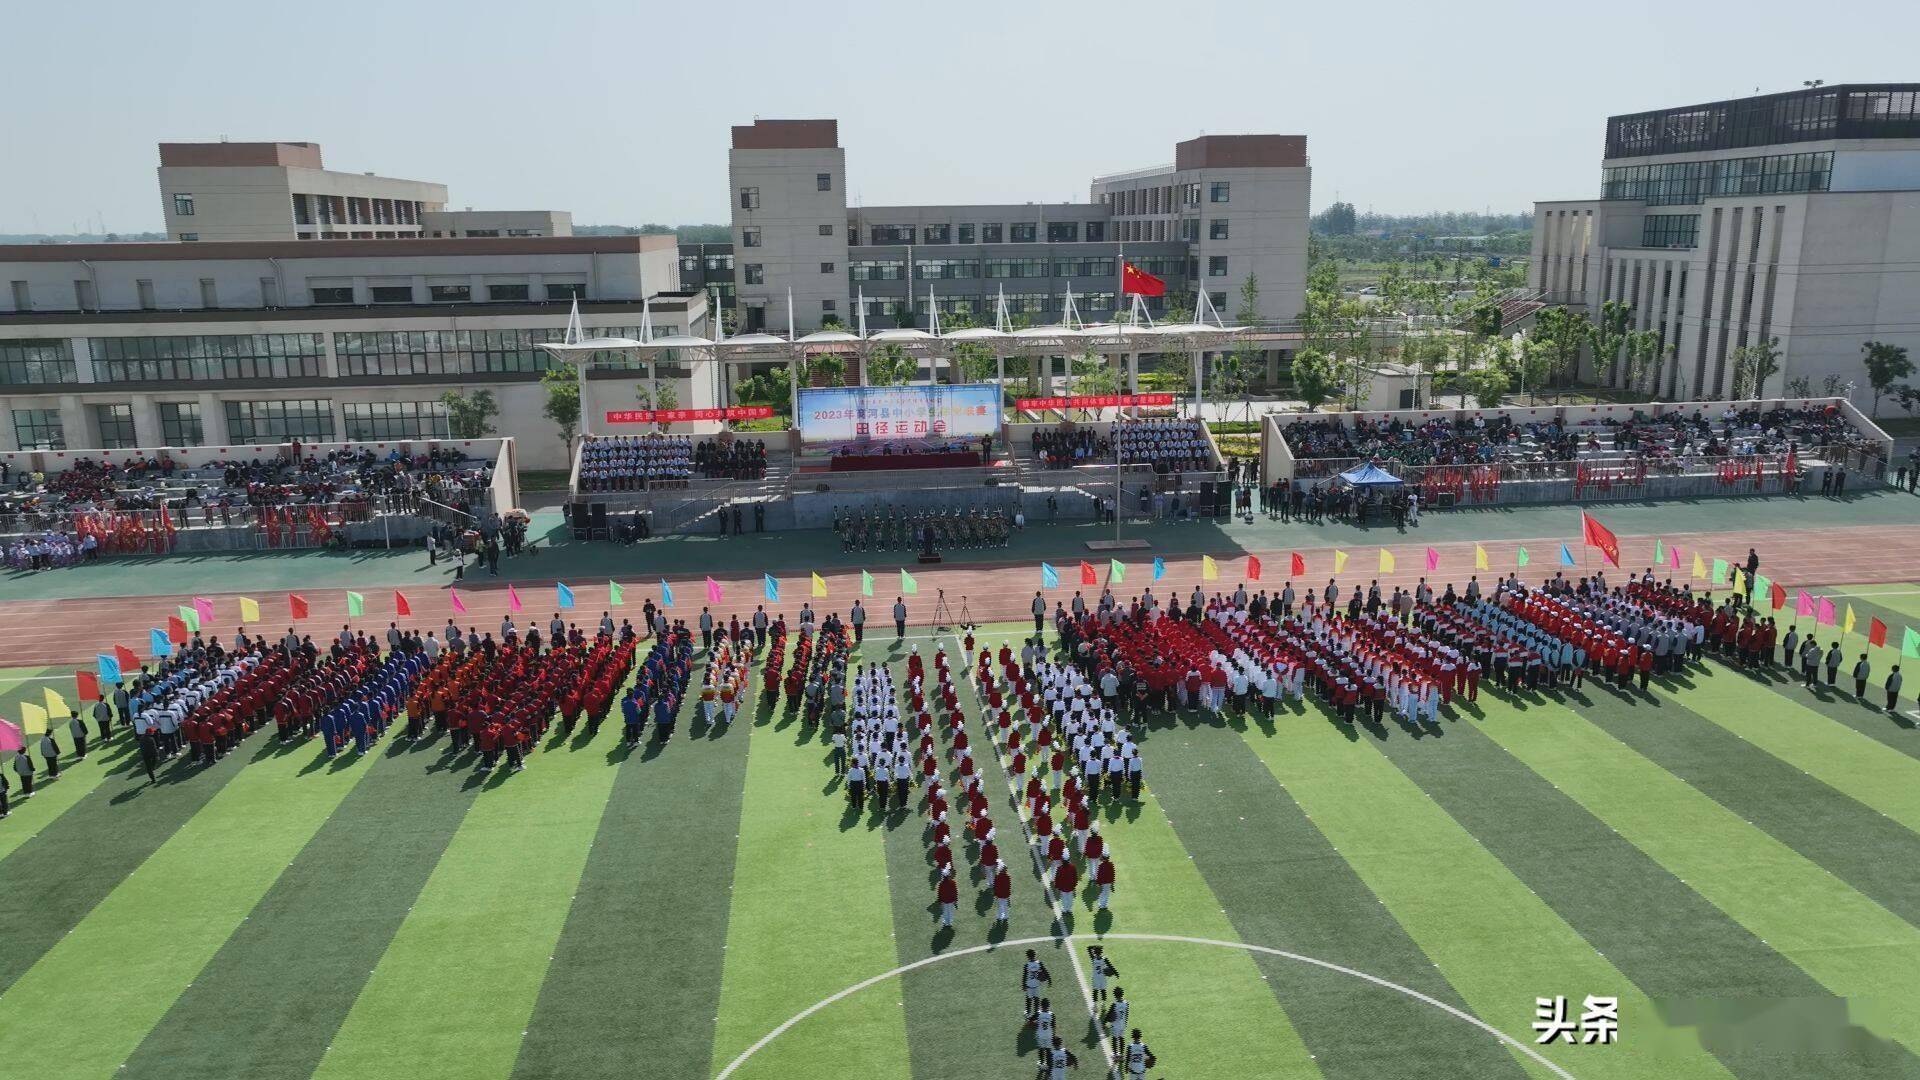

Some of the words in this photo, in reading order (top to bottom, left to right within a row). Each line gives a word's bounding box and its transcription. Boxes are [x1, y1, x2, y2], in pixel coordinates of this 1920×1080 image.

[856, 420, 946, 434] 田径运动会
